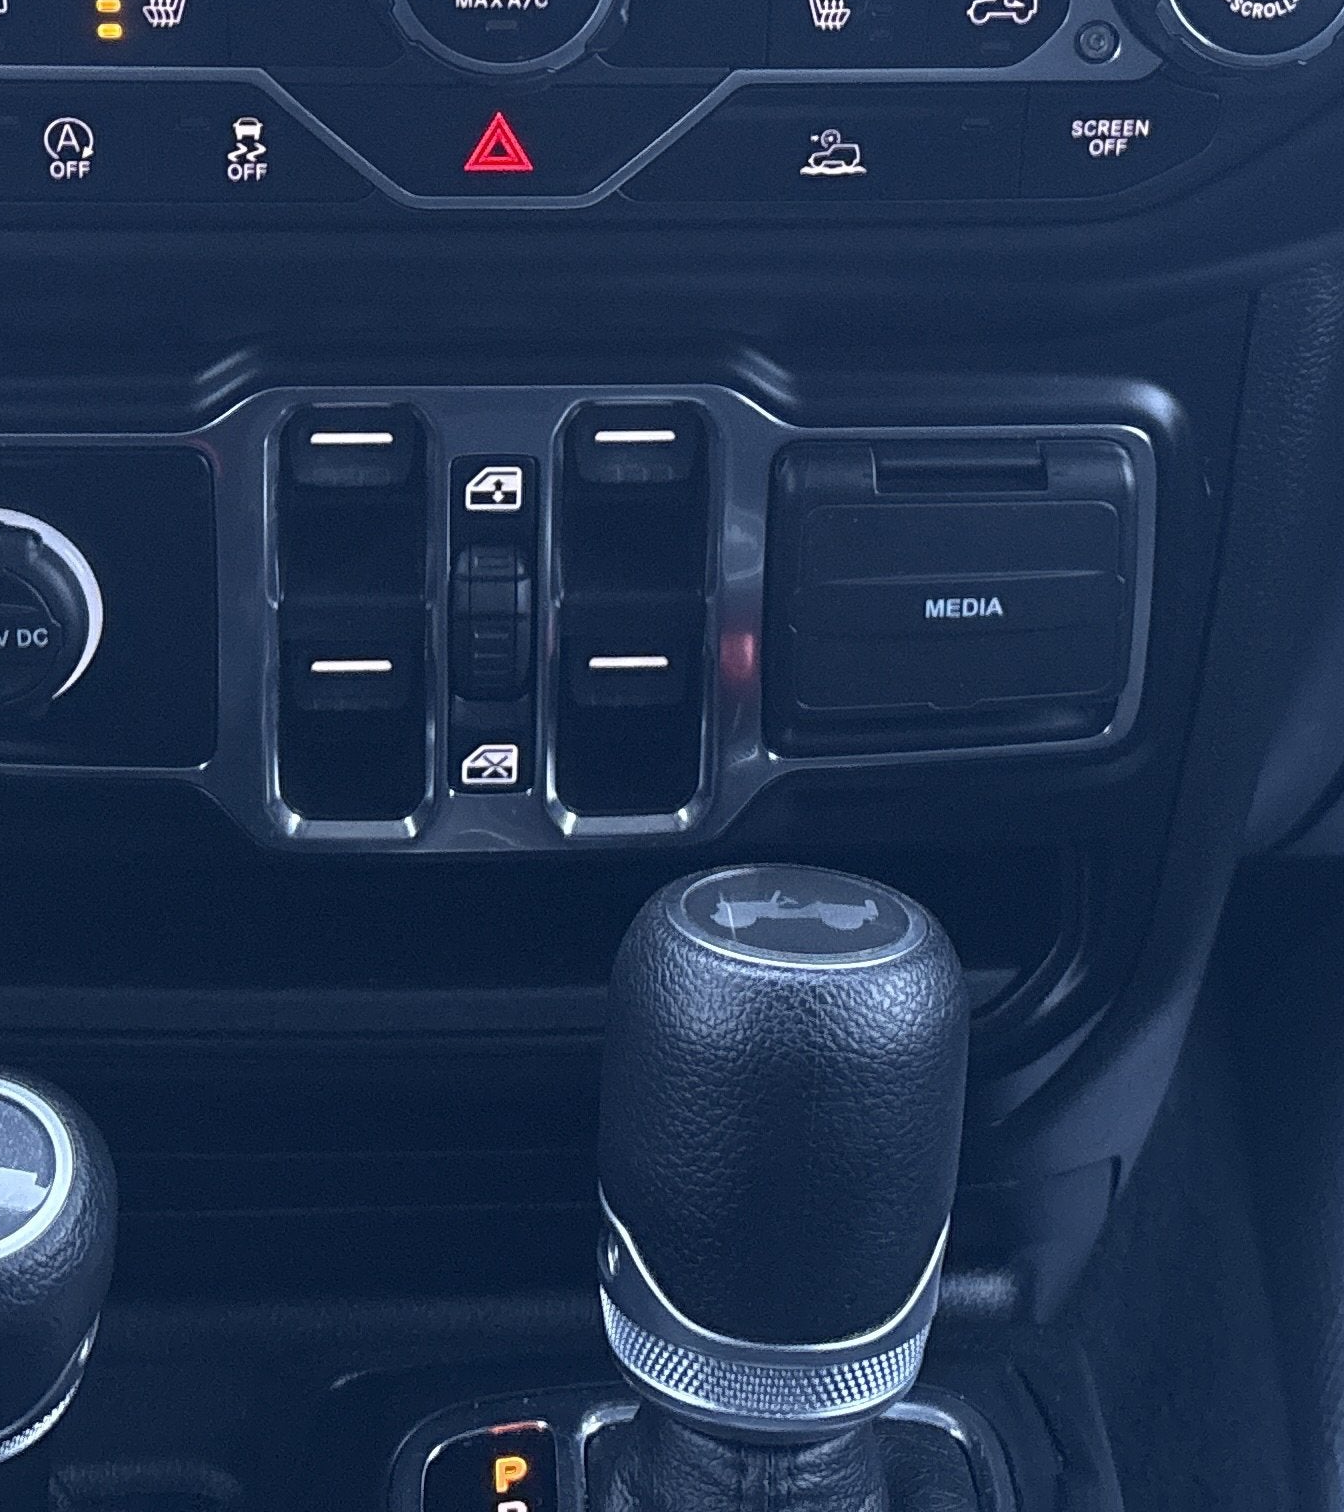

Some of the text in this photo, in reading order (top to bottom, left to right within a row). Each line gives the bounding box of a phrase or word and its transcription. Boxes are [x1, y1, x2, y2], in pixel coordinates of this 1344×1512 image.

[1070, 118, 1151, 138] SCREEN
[1088, 138, 1129, 157] OFF
[49, 157, 91, 179] OFF
[227, 159, 268, 181] OFF
[925, 597, 1003, 619] MEDIA
[16, 627, 49, 647] DC
[495, 1456, 528, 1493] P
